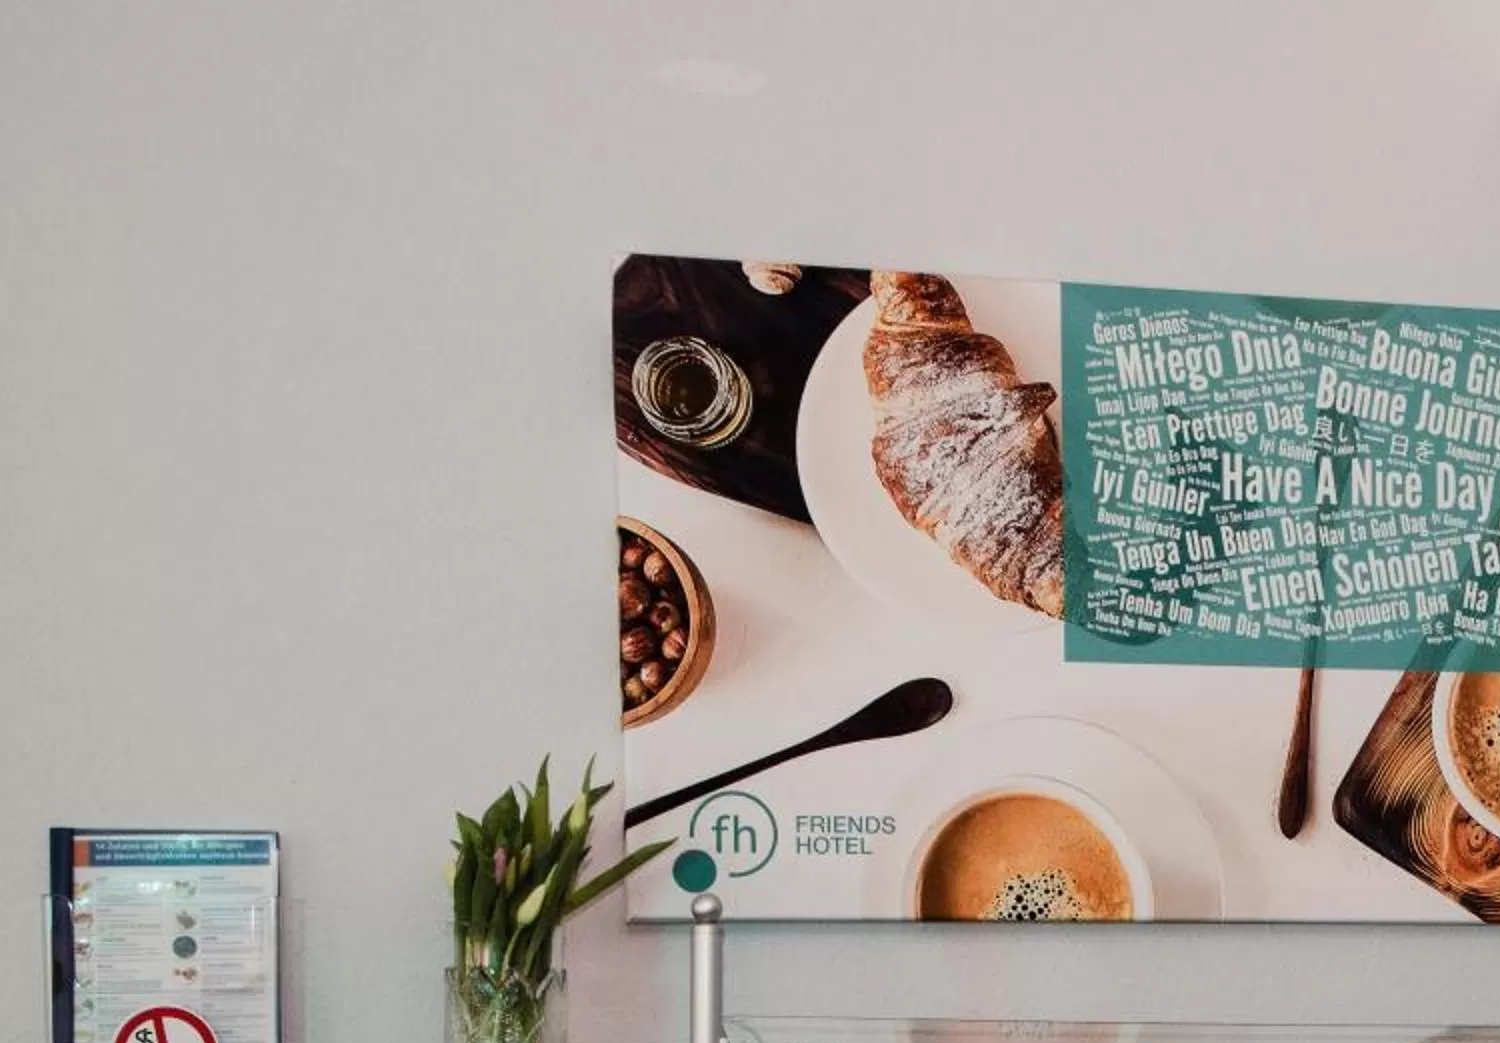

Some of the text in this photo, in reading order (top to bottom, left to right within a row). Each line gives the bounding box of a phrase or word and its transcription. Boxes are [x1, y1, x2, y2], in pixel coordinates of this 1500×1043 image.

[1093, 322, 1136, 344] Geros
[1139, 317, 1189, 338] Dienos
[1232, 330, 1300, 375] Dnia
[1370, 328, 1457, 389] Buona
[1162, 388, 1186, 406] Dan
[1315, 365, 1407, 427] Bonne
[1120, 419, 1161, 452] Een
[1167, 406, 1258, 446] Prettige
[1264, 400, 1308, 435] Dag
[1132, 469, 1210, 516] Günler
[1222, 452, 1495, 523] Have A Nice Day
[1112, 540, 1180, 575] Tenga
[1185, 529, 1216, 562] Un
[1220, 525, 1274, 557] Buen
[1318, 525, 1345, 547] Hav
[1350, 521, 1367, 543] En
[1370, 513, 1397, 540] God
[1400, 513, 1429, 537] Dag
[1240, 566, 1325, 611] Einen
[1333, 544, 1459, 598] Schönen
[1464, 580, 1488, 613] Ha
[1120, 587, 1164, 619] Tenha
[1169, 598, 1193, 625] Um
[1198, 605, 1231, 633] Bom
[1236, 612, 1260, 640] Dia
[1320, 590, 1450, 635] Хорошего Дня
[711, 814, 757, 854] fh
[795, 815, 896, 835] FRIENDS
[795, 837, 873, 855] HOTEL
